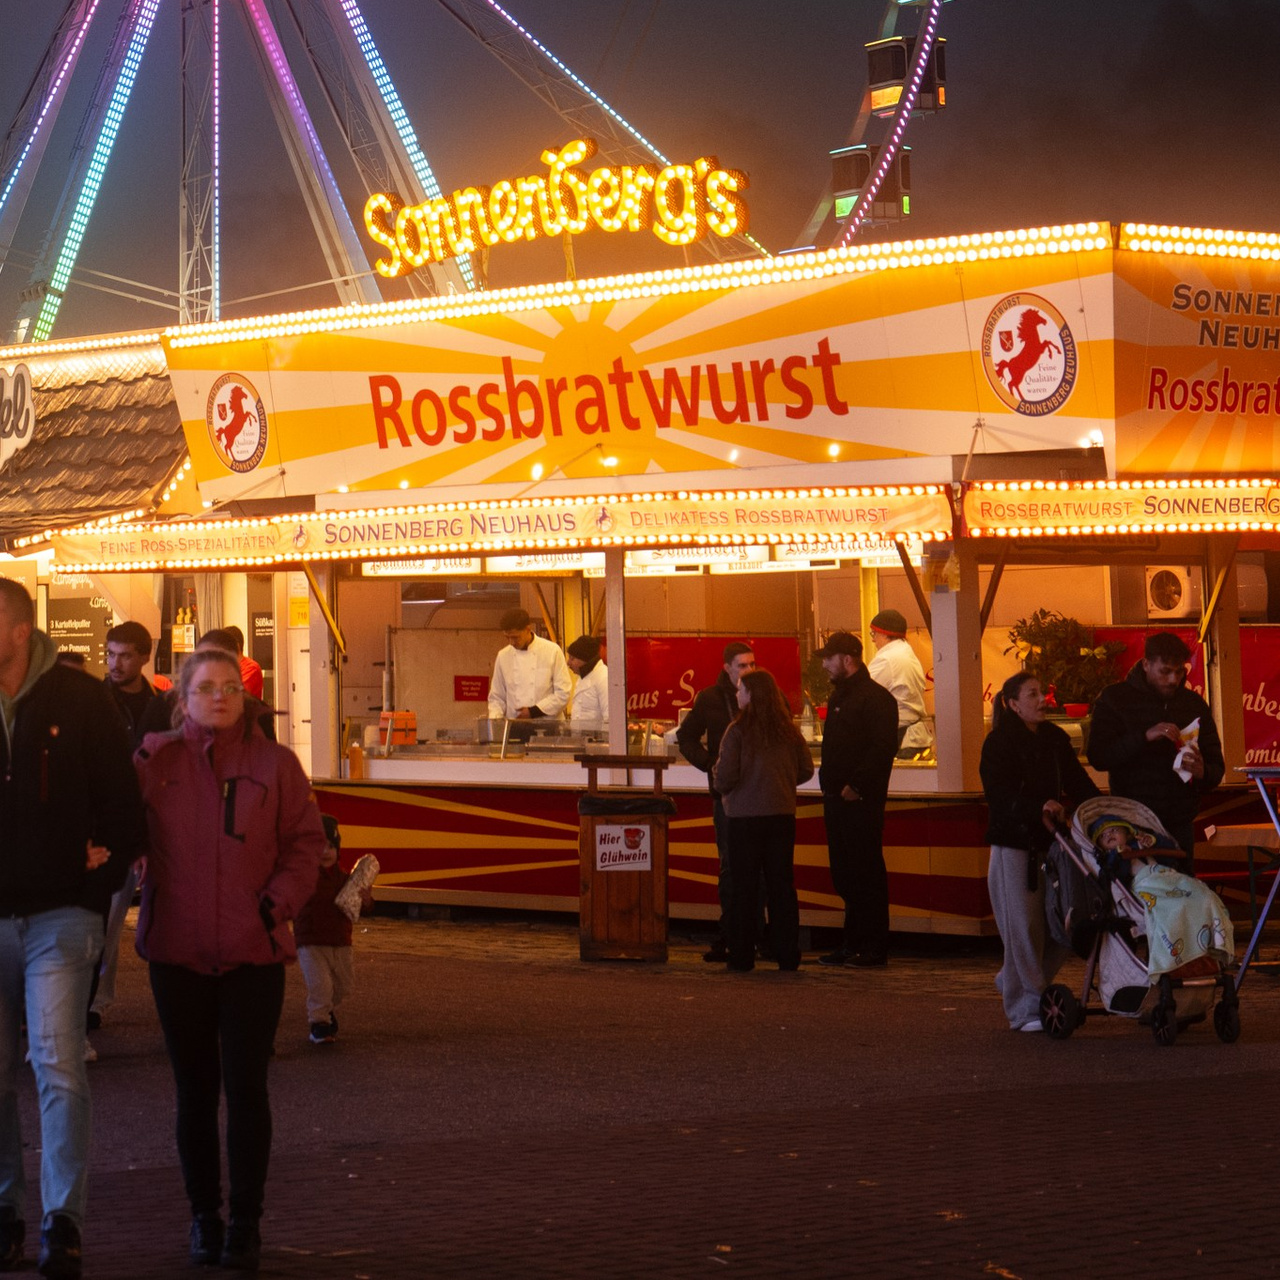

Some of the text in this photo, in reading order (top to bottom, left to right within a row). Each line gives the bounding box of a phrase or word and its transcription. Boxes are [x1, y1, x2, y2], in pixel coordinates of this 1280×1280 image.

[363, 138, 748, 278] Sonnenberg's
[1020, 329, 1075, 414] SONNENBERG NEUHAUS
[368, 336, 849, 449] Rossbratwurst
[232, 402, 267, 471] SONNENBERG NEUHAUS
[630, 508, 889, 527] DELIKATESS ROSSBRATWURST
[980, 501, 1133, 519] ROSSBRATWURST
[325, 513, 577, 544] SONNENBERG NEUHAUS
[100, 532, 276, 554] FEINE ROSS-SPEZIALITÄTEN
[599, 832, 621, 846] Hier
[600, 849, 648, 864] Glühwein
